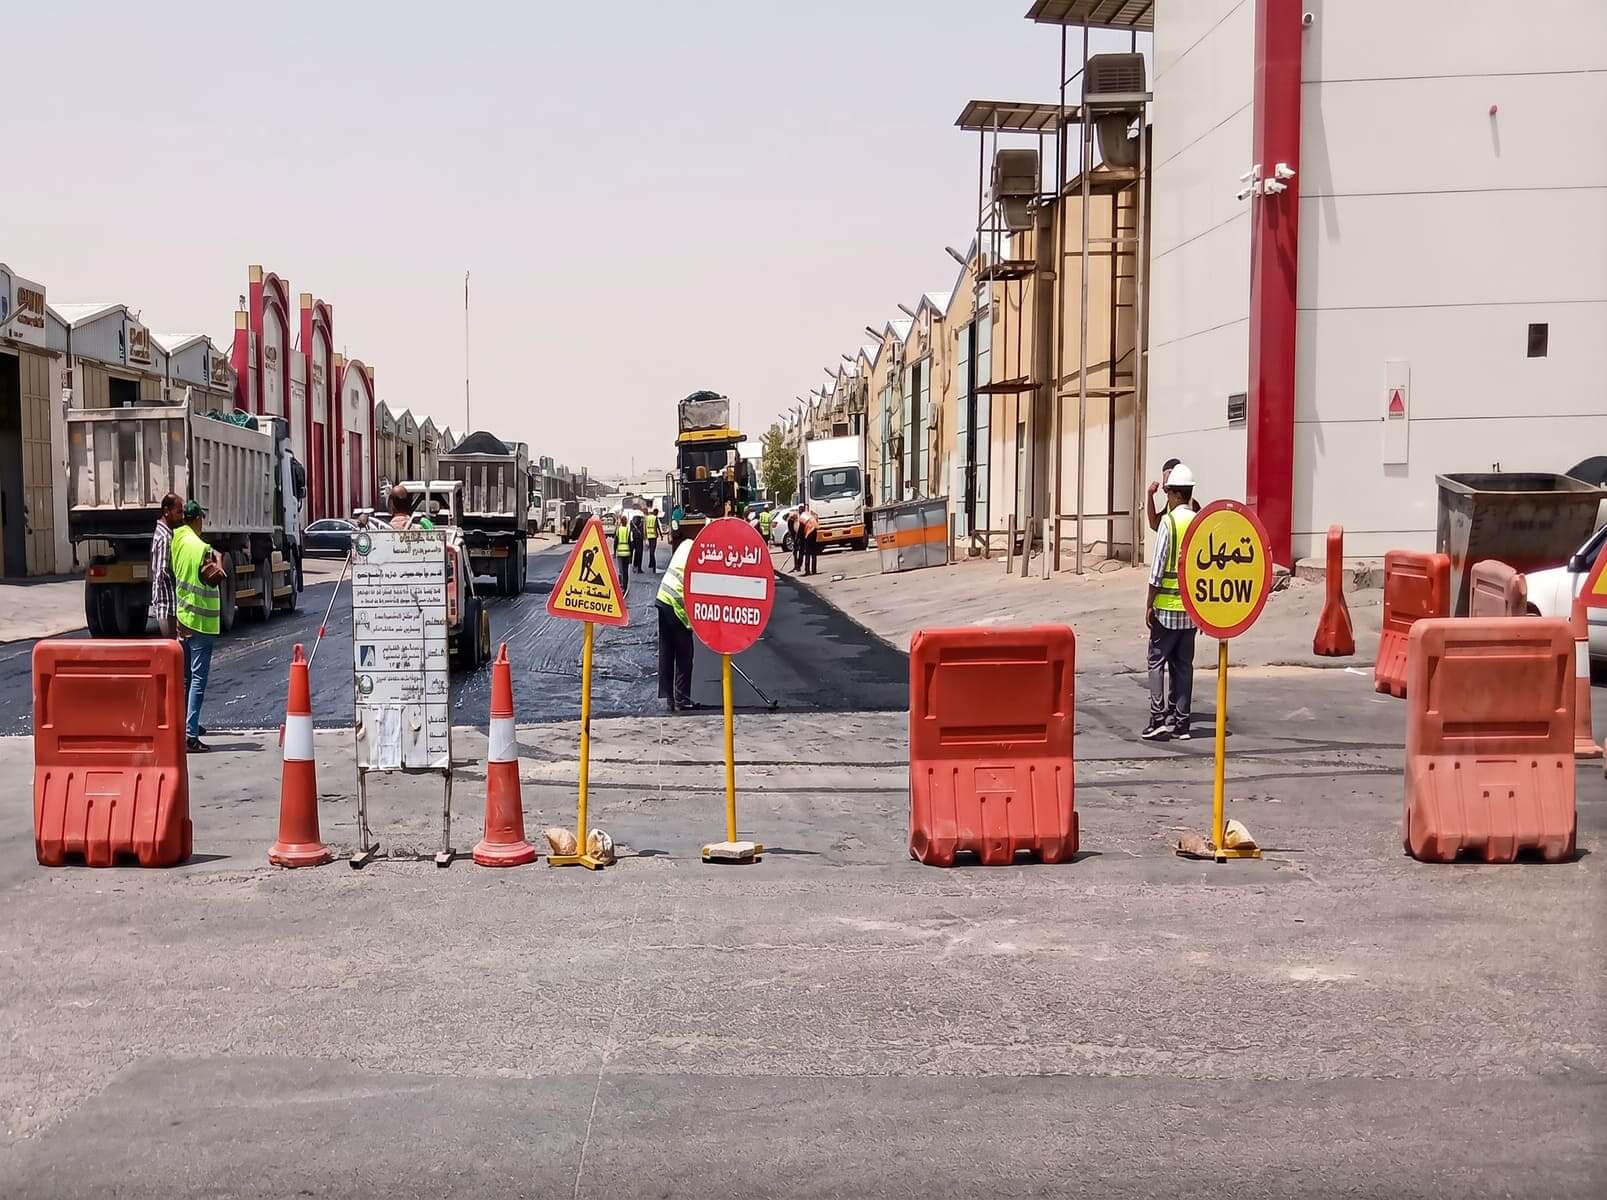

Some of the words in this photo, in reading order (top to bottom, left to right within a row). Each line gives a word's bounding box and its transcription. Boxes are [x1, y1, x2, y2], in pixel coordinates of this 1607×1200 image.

[724, 545, 762, 568] الطريق
[1196, 532, 1255, 570] تمهل
[1195, 578, 1253, 603] SLOW
[694, 603, 721, 621] ROAD
[722, 605, 761, 626] CLOSED
